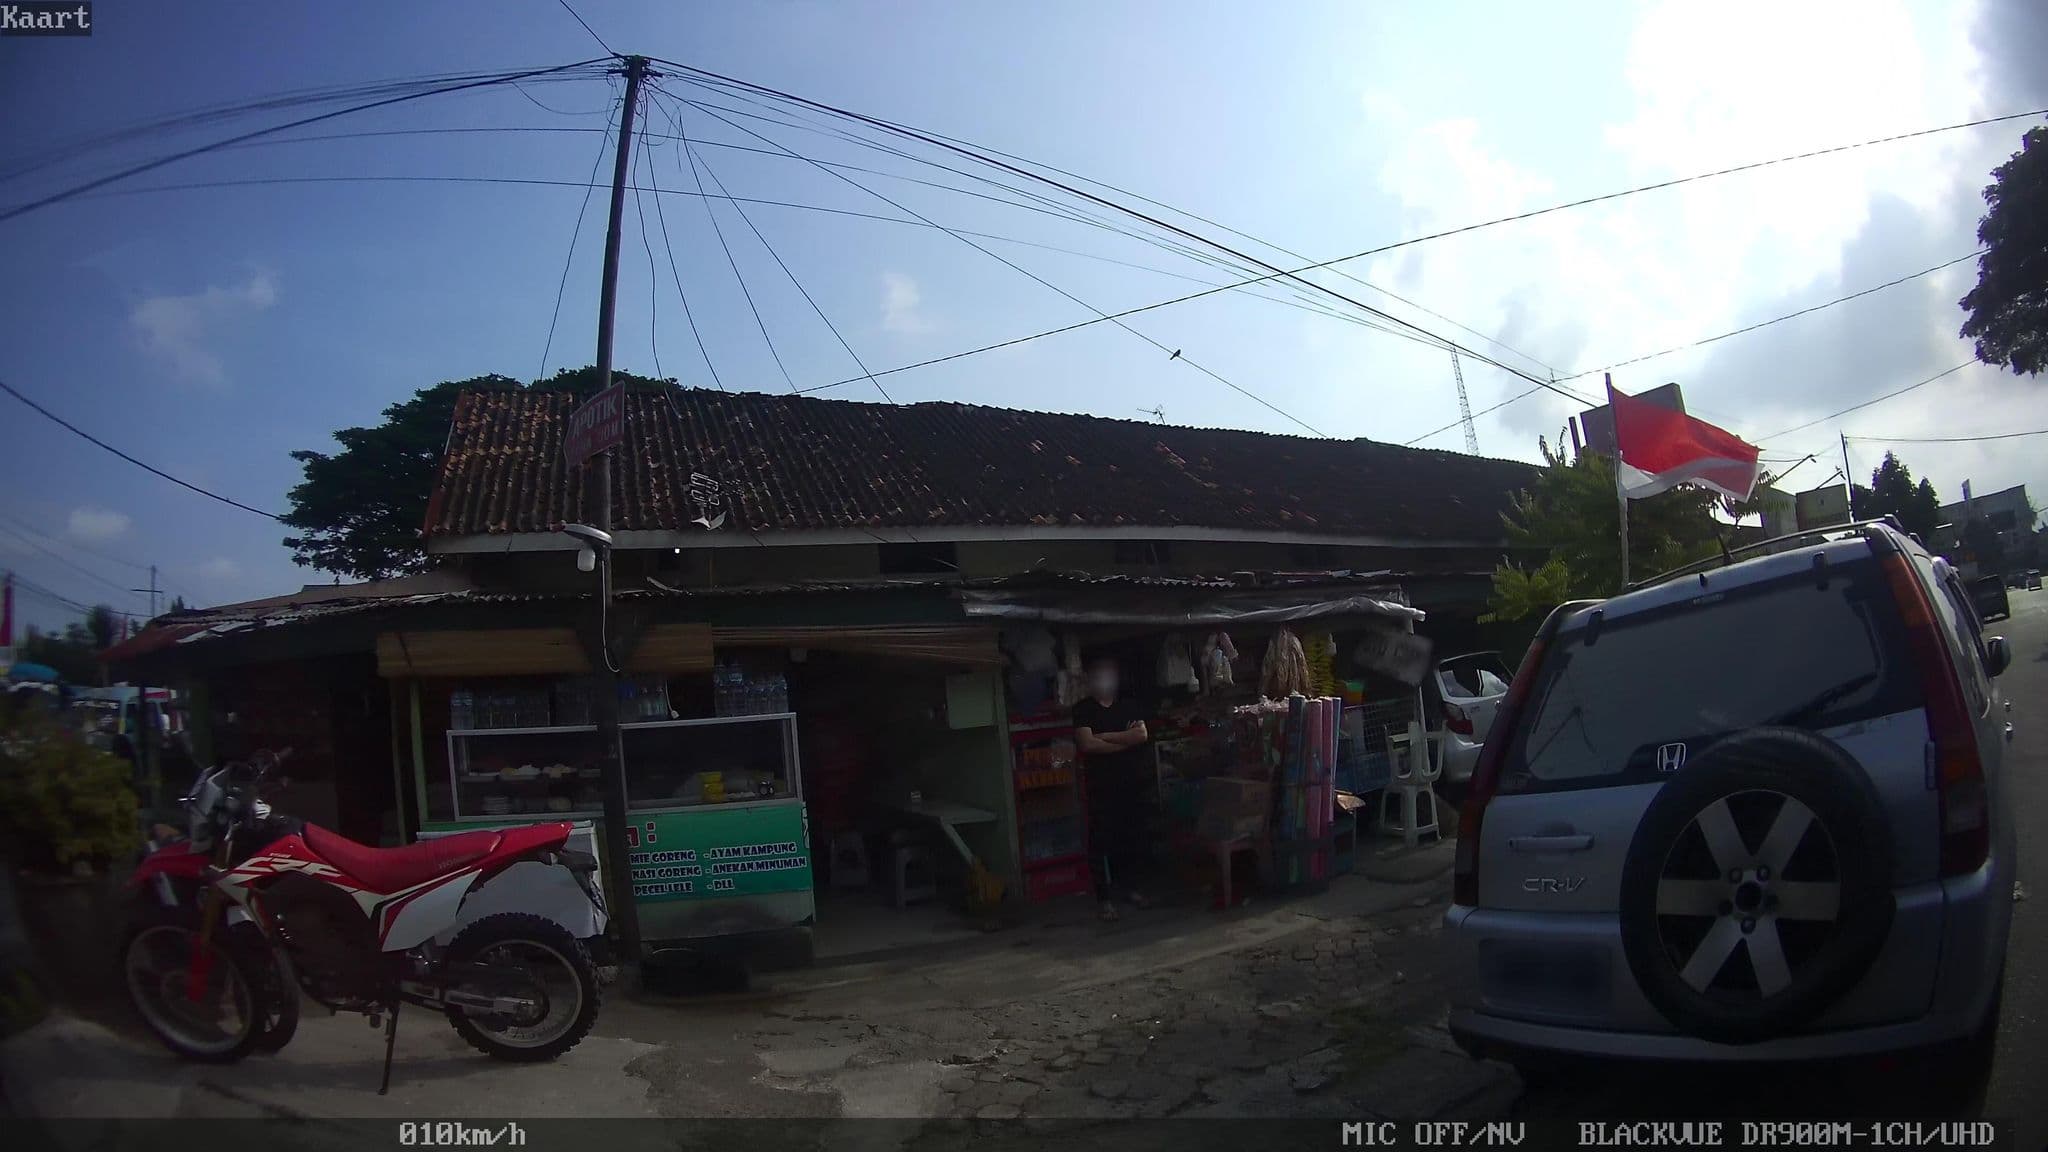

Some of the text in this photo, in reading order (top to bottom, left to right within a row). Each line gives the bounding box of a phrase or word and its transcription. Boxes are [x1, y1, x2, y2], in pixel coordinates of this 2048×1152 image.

[570, 393, 617, 439] APOTIK
[630, 853, 650, 864] MIE
[651, 850, 696, 863] GORENG
[710, 848, 741, 859] AYAM
[742, 842, 797, 856] KAMPUNG
[632, 868, 656, 880] NASI
[657, 865, 702, 878] GORENG
[755, 856, 807, 871] MINUMAN
[633, 883, 666, 896] PECEL
[667, 881, 693, 893] LELE
[713, 879, 735, 890] DLL
[1521, 877, 1584, 892] CR-V
